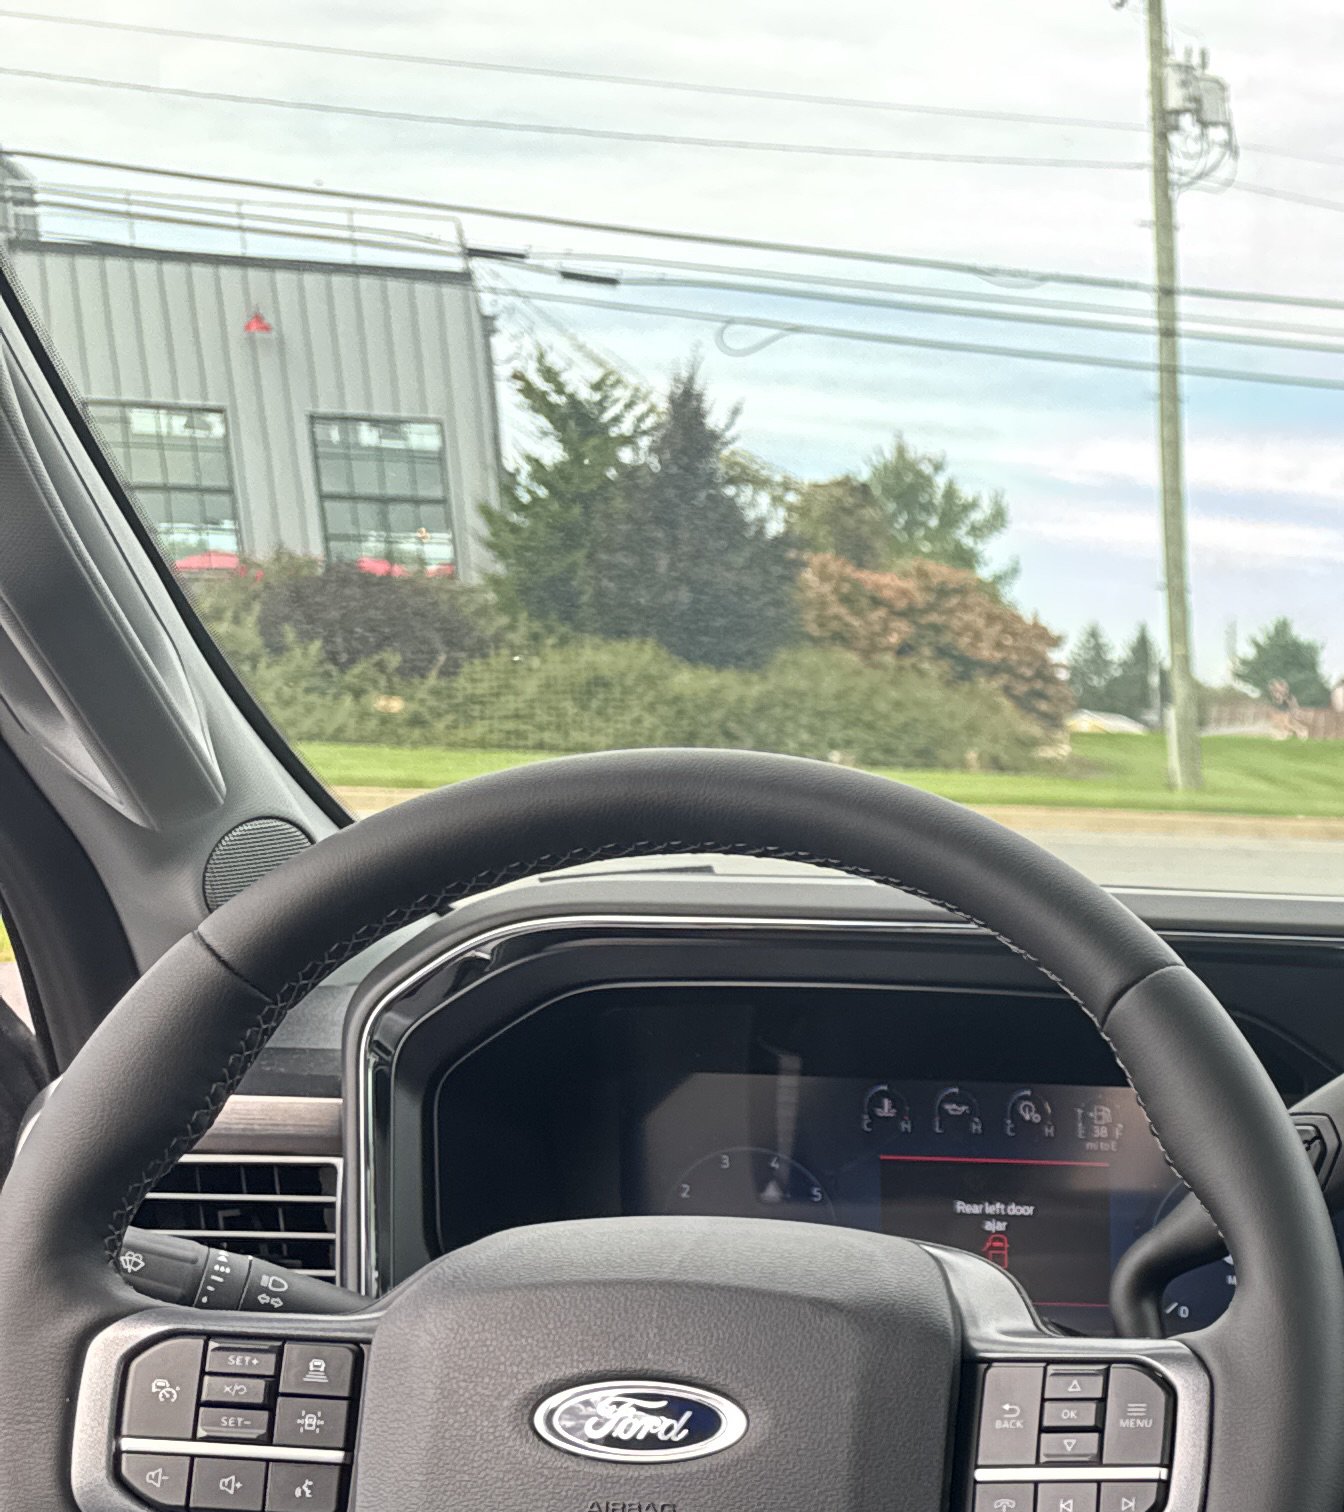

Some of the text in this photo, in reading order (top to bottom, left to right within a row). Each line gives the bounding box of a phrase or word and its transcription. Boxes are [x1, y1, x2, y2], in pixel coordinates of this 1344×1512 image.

[721, 1155, 730, 1168] 3
[770, 1156, 780, 1169] 4
[681, 1184, 690, 1198] 2
[812, 1187, 822, 1201] 5
[956, 1200, 1035, 1216] Rear left door
[982, 1220, 1008, 1234] ajar
[227, 1354, 259, 1366] SET+
[584, 1397, 693, 1442] Ford
[1061, 1409, 1078, 1419] OK
[995, 1419, 1024, 1429] BACK
[1119, 1418, 1153, 1428] MENU
